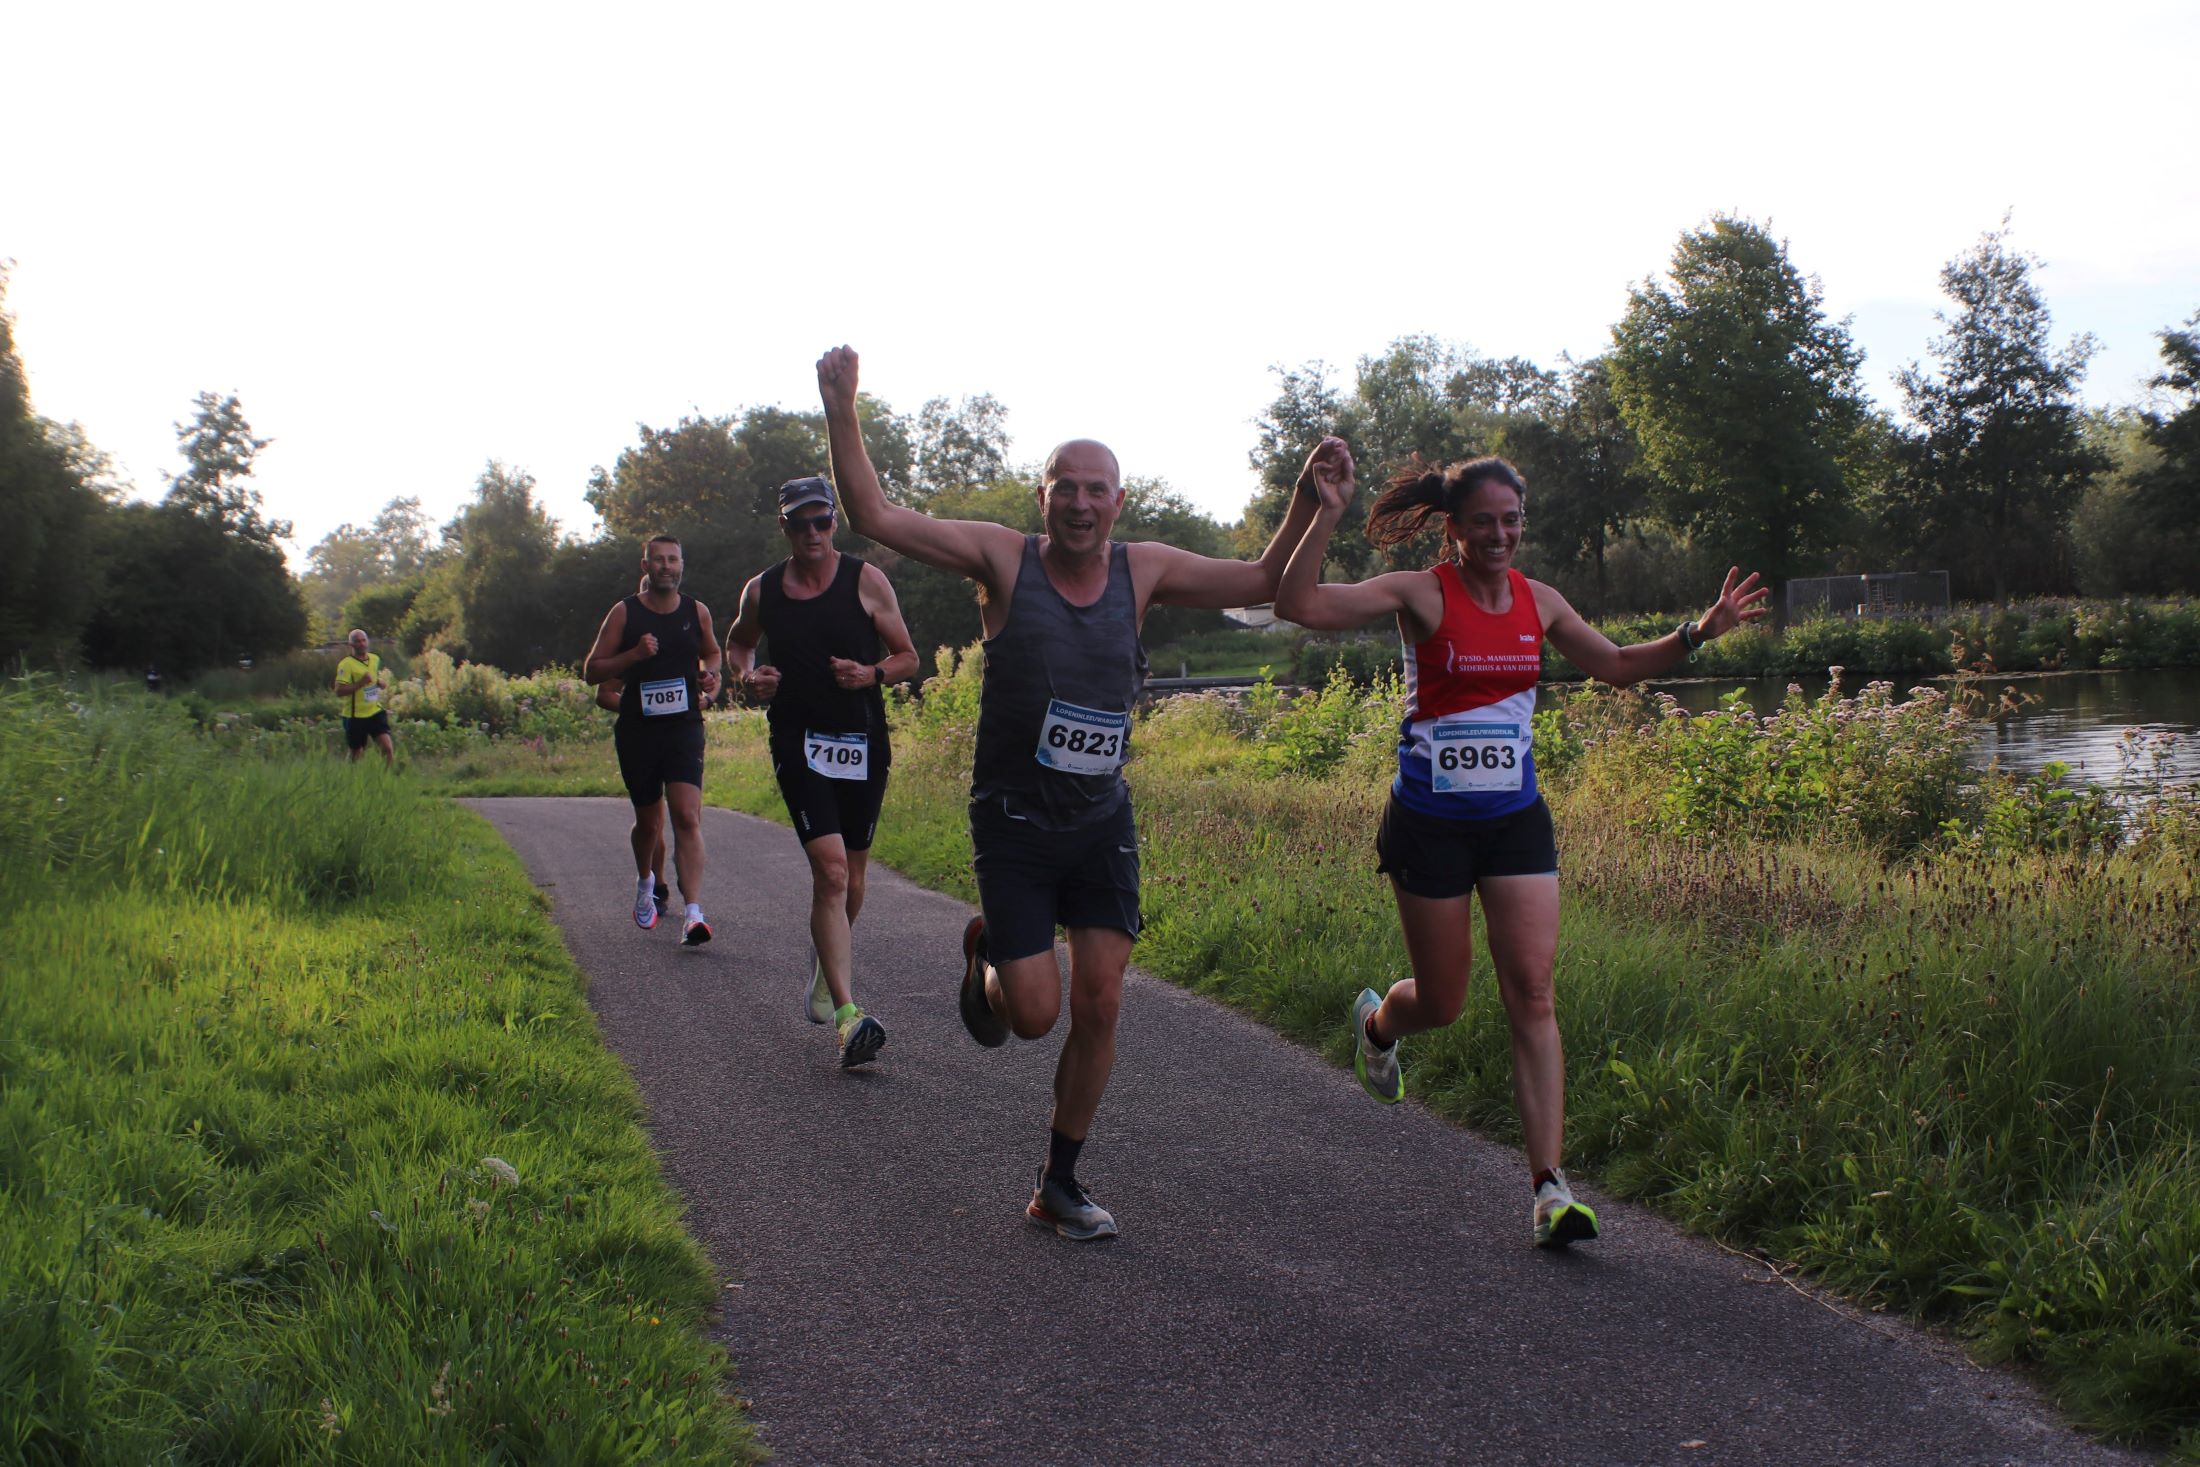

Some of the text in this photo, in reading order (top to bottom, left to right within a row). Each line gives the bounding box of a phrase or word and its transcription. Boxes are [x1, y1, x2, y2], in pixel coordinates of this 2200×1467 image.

[644, 689, 684, 706] 7087
[1048, 724, 1119, 757] 6823
[809, 744, 862, 765] 7109
[1439, 746, 1516, 770] 6963
